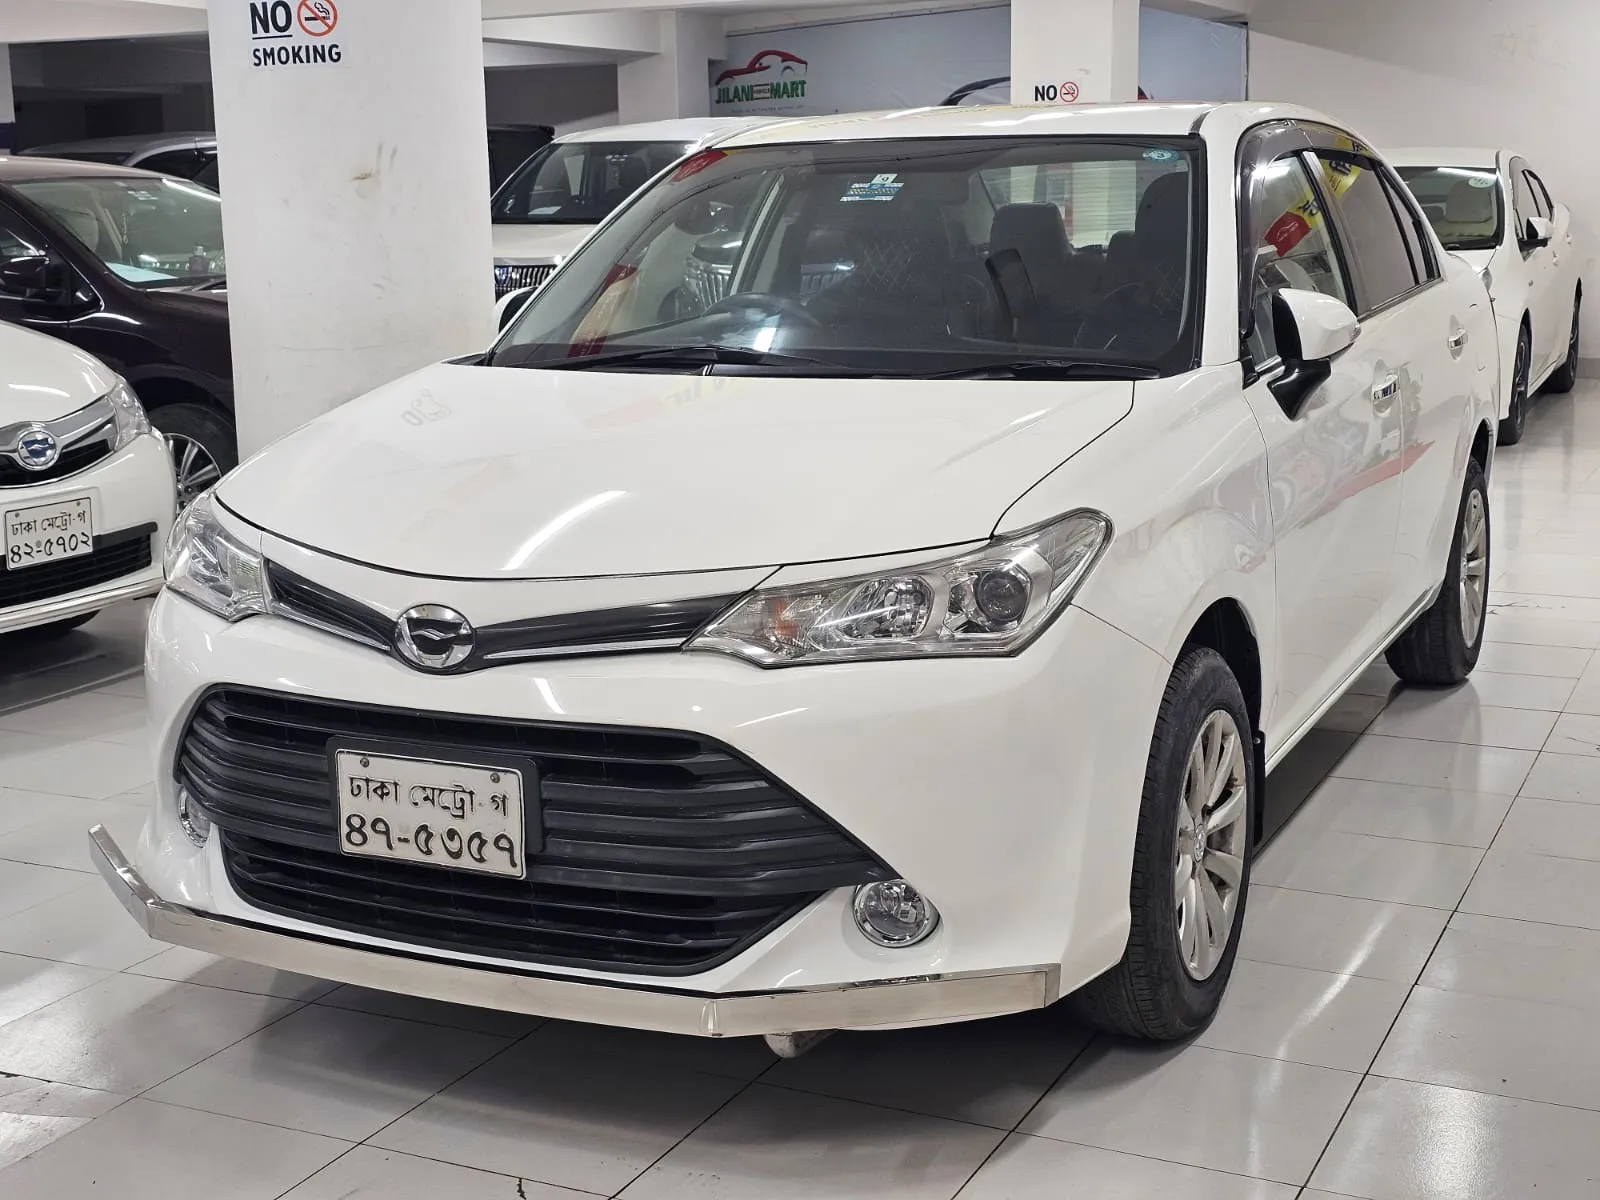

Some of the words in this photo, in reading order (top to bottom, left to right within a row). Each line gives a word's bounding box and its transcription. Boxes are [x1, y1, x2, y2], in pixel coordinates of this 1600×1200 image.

[249, 0, 293, 35] NO
[252, 43, 342, 67] SMOKING
[715, 84, 754, 104] JILANI
[769, 80, 807, 99] MART
[1034, 84, 1058, 102] NO
[11, 519, 37, 536] ঢাকা
[10, 531, 91, 563] ৪২-৫৭০২
[348, 775, 400, 805] ঢাকা
[345, 812, 519, 869] ৪৭-৫৩৫৭
